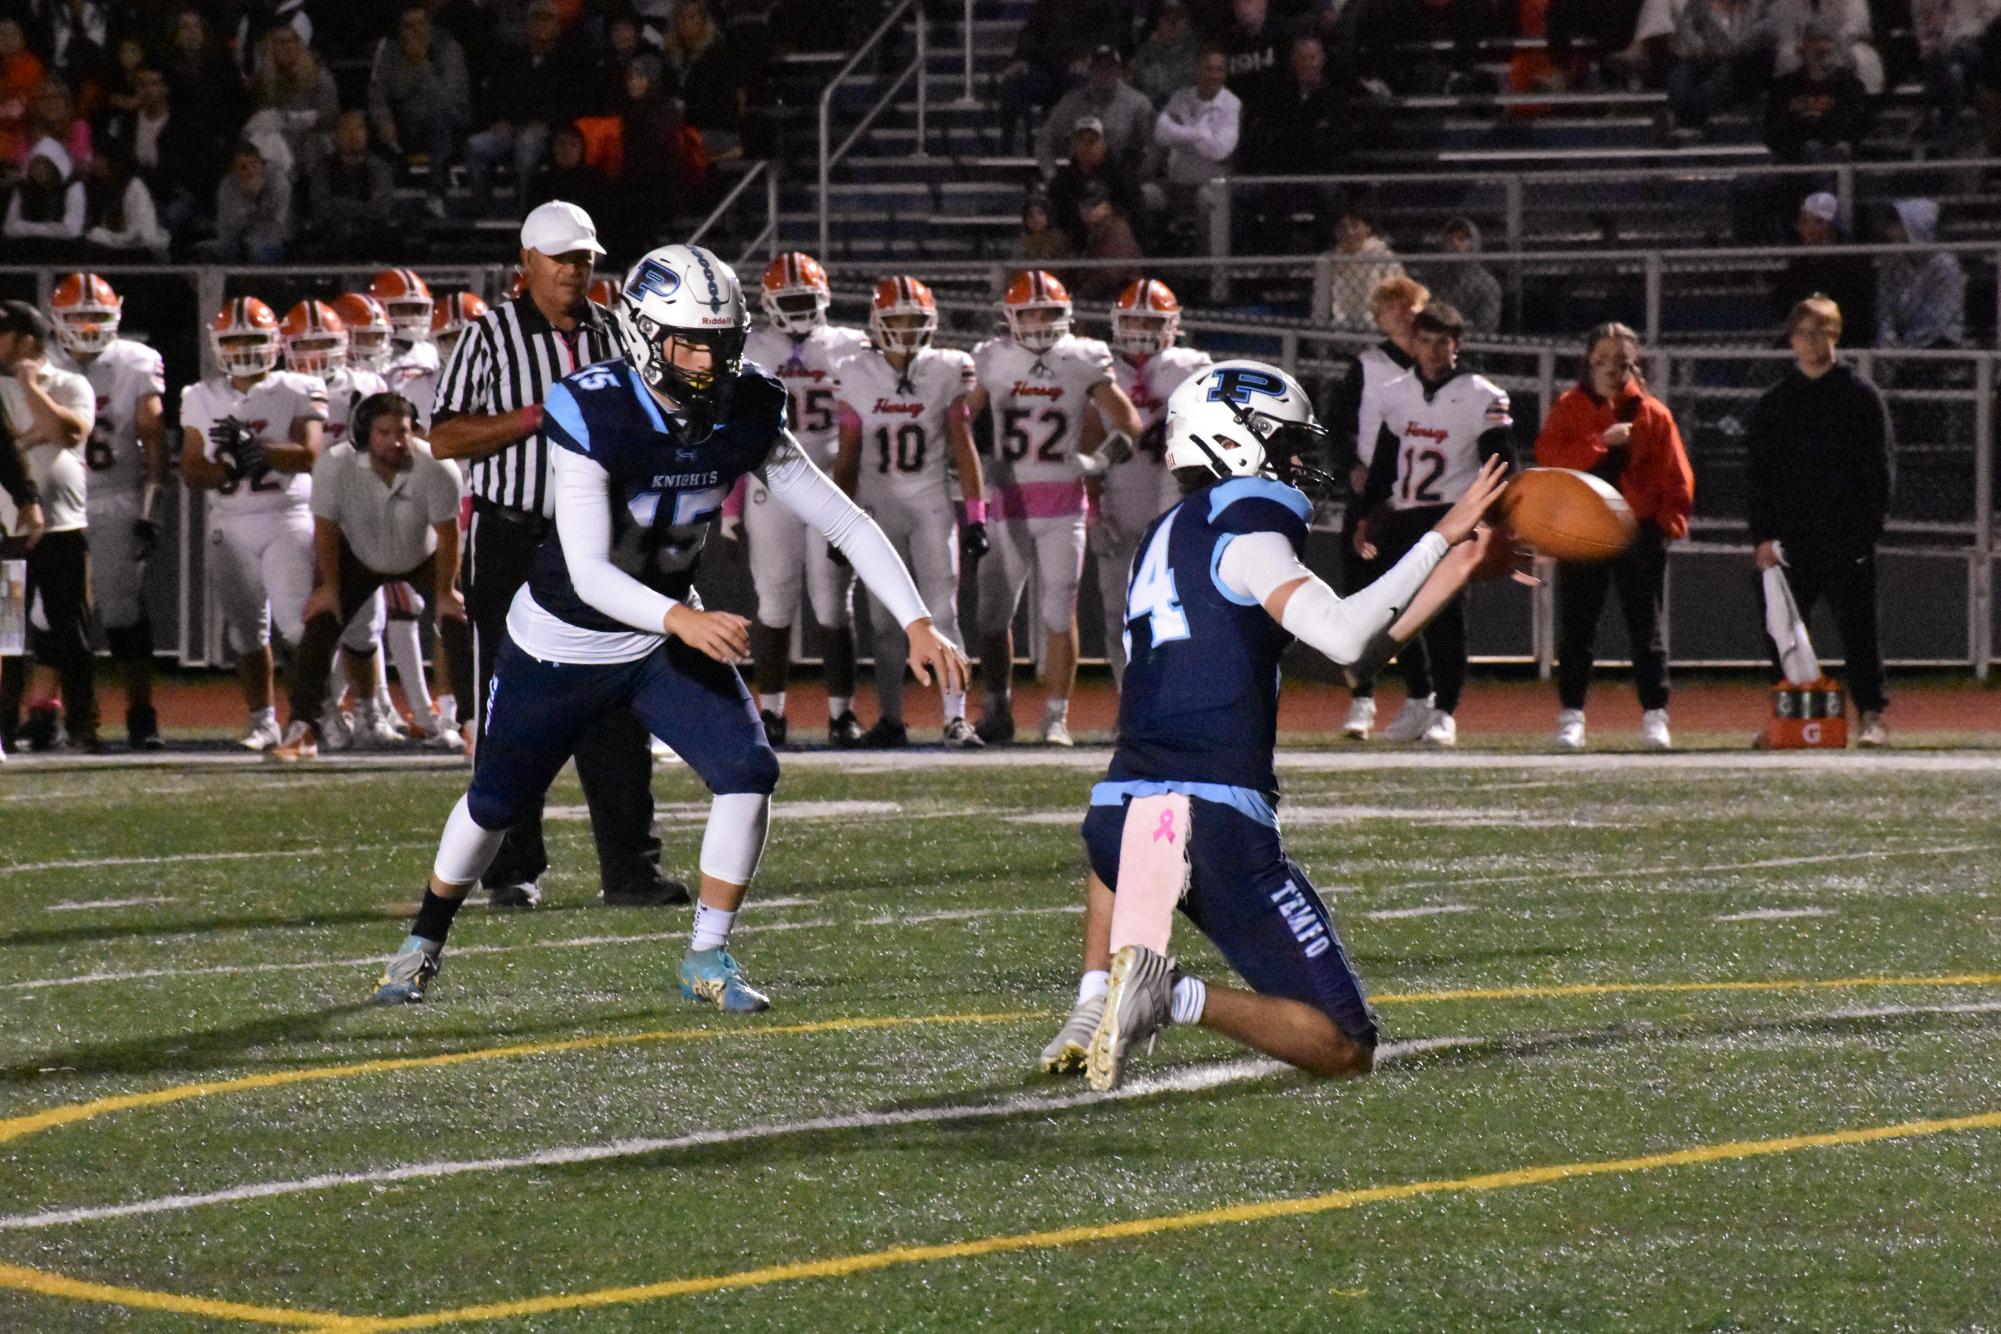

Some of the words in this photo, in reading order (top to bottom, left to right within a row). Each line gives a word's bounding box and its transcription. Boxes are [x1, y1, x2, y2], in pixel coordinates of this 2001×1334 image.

[625, 258, 681, 301] P
[702, 317, 732, 325] Riddell
[569, 366, 621, 390] 15
[1207, 367, 1287, 403] P
[1009, 380, 1063, 401] Hersey
[872, 397, 925, 418] Hersey
[1002, 407, 1067, 463] 52
[876, 424, 926, 474] 10
[651, 471, 718, 488] KNIGHTS
[1402, 449, 1446, 501] 12
[1802, 723, 1821, 744] G
